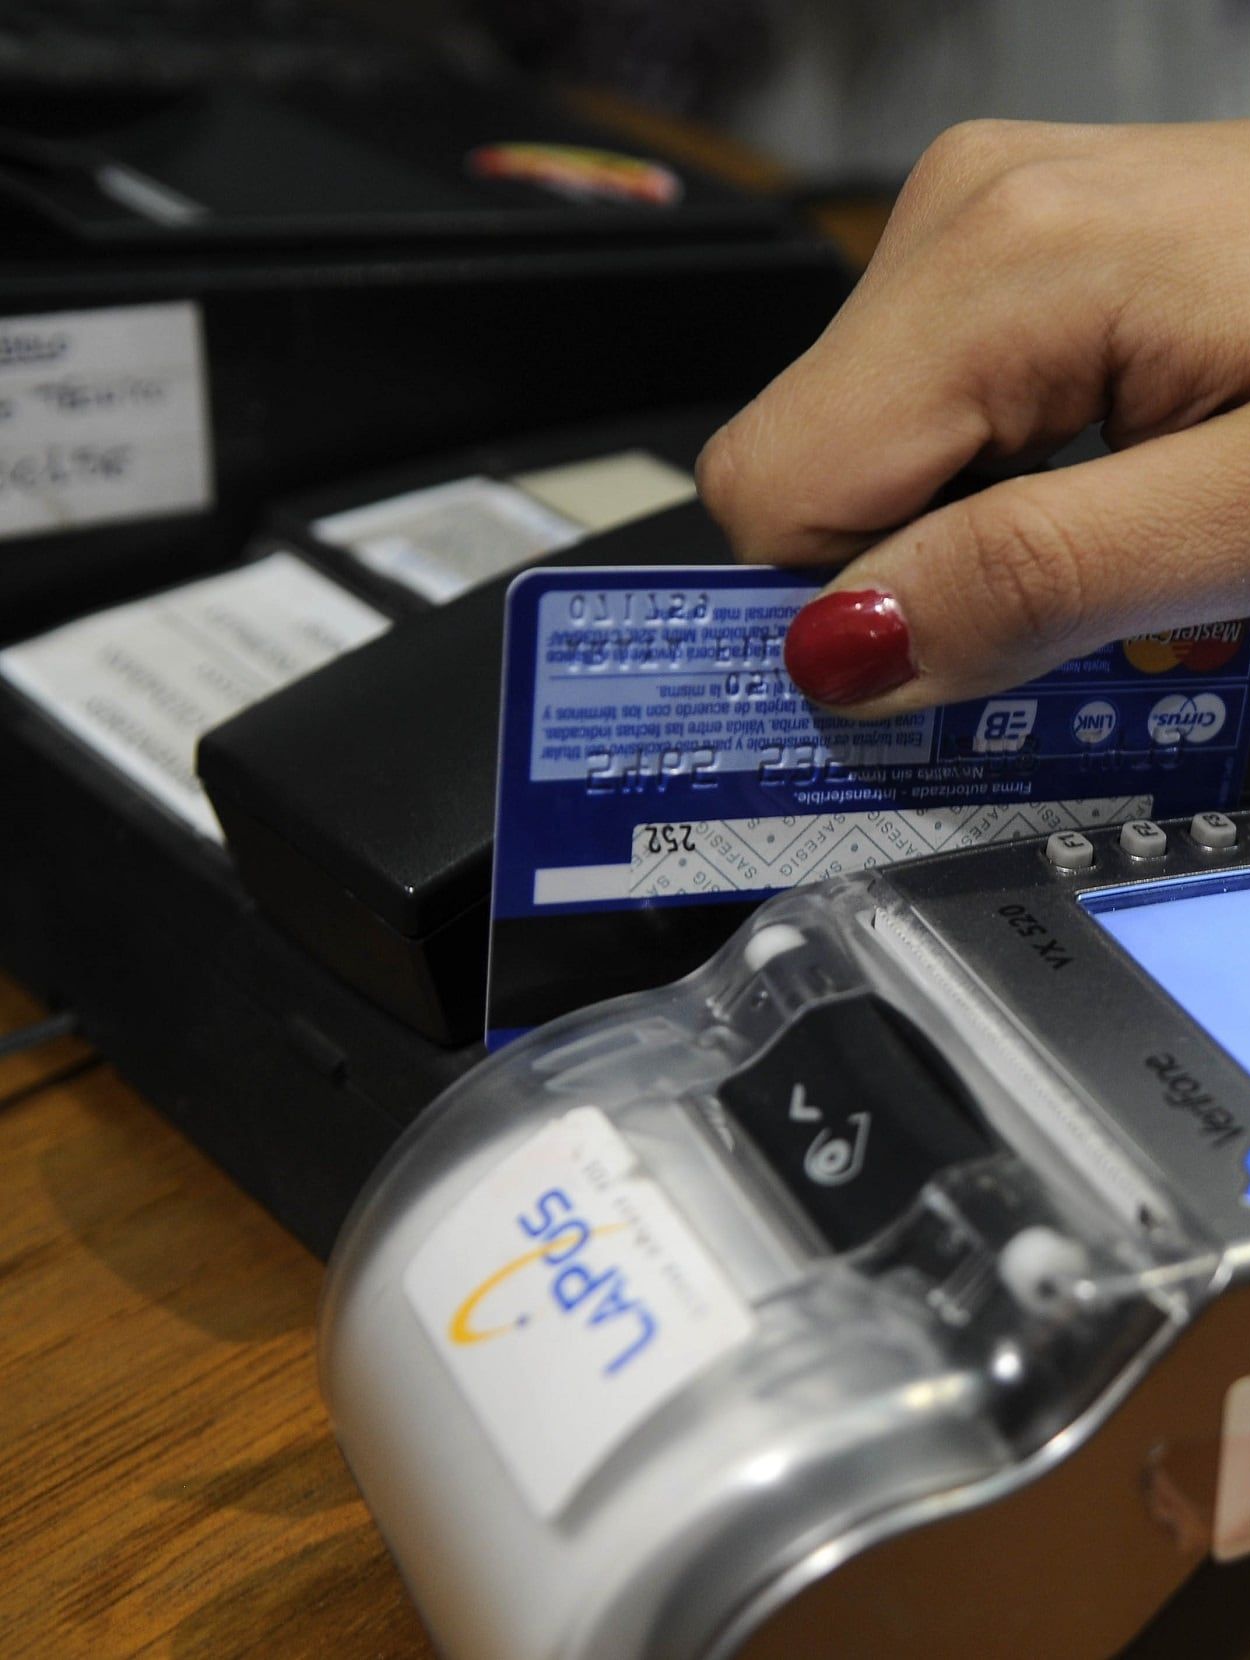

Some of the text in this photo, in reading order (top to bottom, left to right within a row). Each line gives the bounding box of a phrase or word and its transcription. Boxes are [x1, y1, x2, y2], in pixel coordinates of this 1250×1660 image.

[1074, 714, 1115, 732] LINK
[911, 783, 989, 800] autorizada
[992, 781, 1032, 797] Firma
[645, 824, 695, 852] 252
[1132, 822, 1159, 837] F2
[1058, 832, 1085, 848] F1
[998, 904, 1077, 971] VX 520
